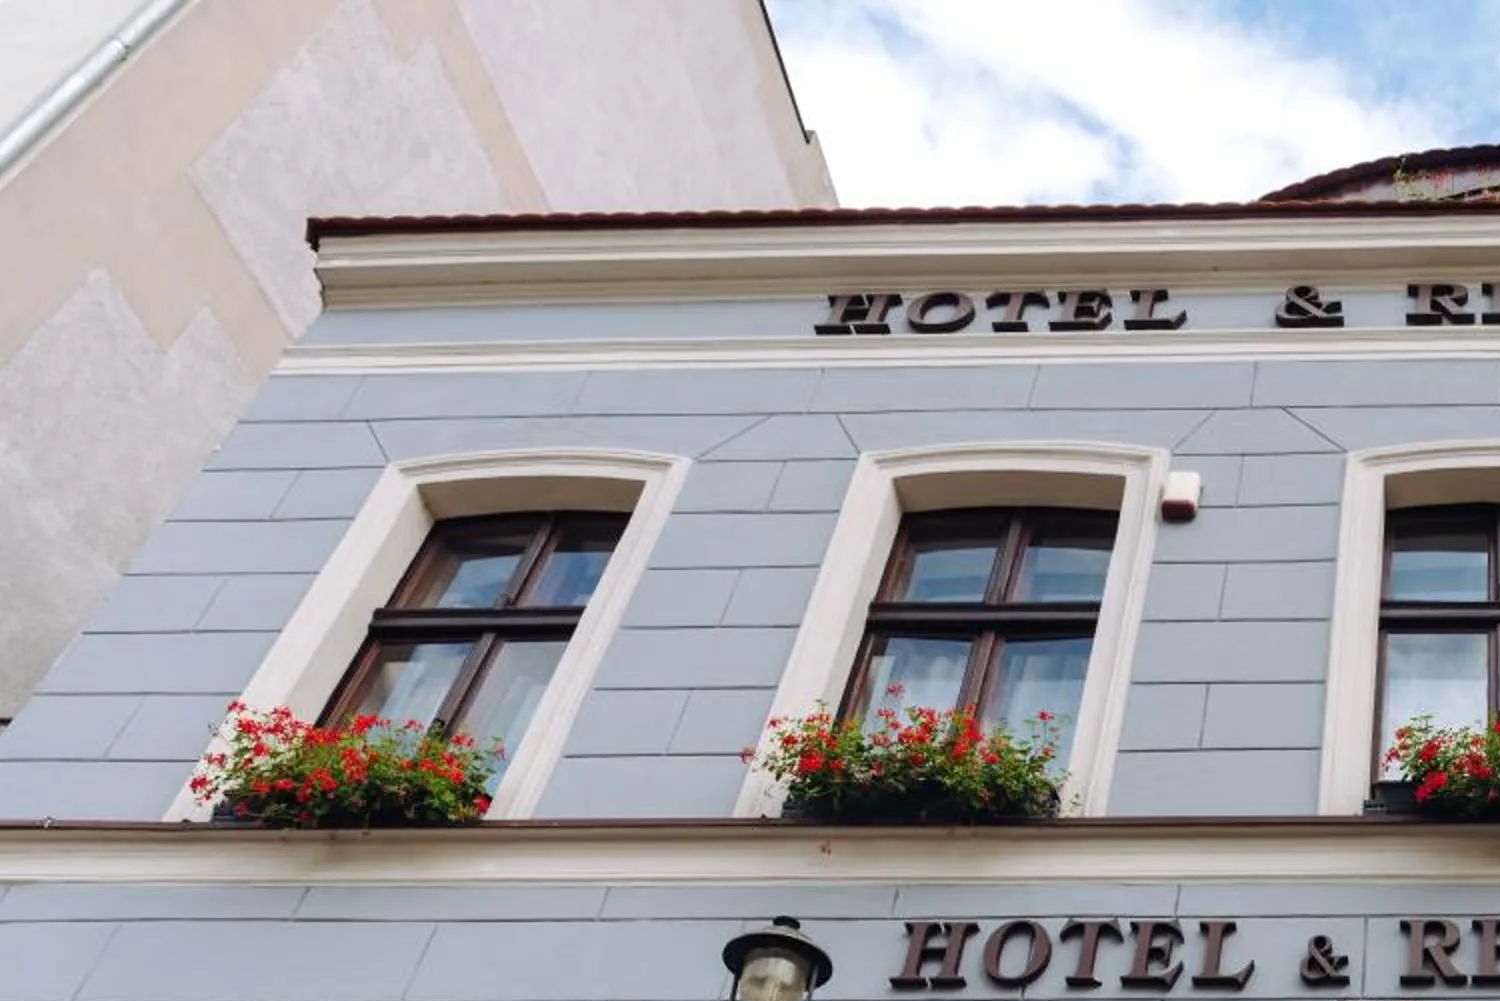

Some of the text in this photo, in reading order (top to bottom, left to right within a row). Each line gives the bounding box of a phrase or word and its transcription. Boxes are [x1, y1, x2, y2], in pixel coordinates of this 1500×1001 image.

[815, 287, 1187, 335] HOTEL
[1275, 285, 1344, 328] &
[889, 917, 1256, 992] HOTEL
[1301, 934, 1351, 988] &
